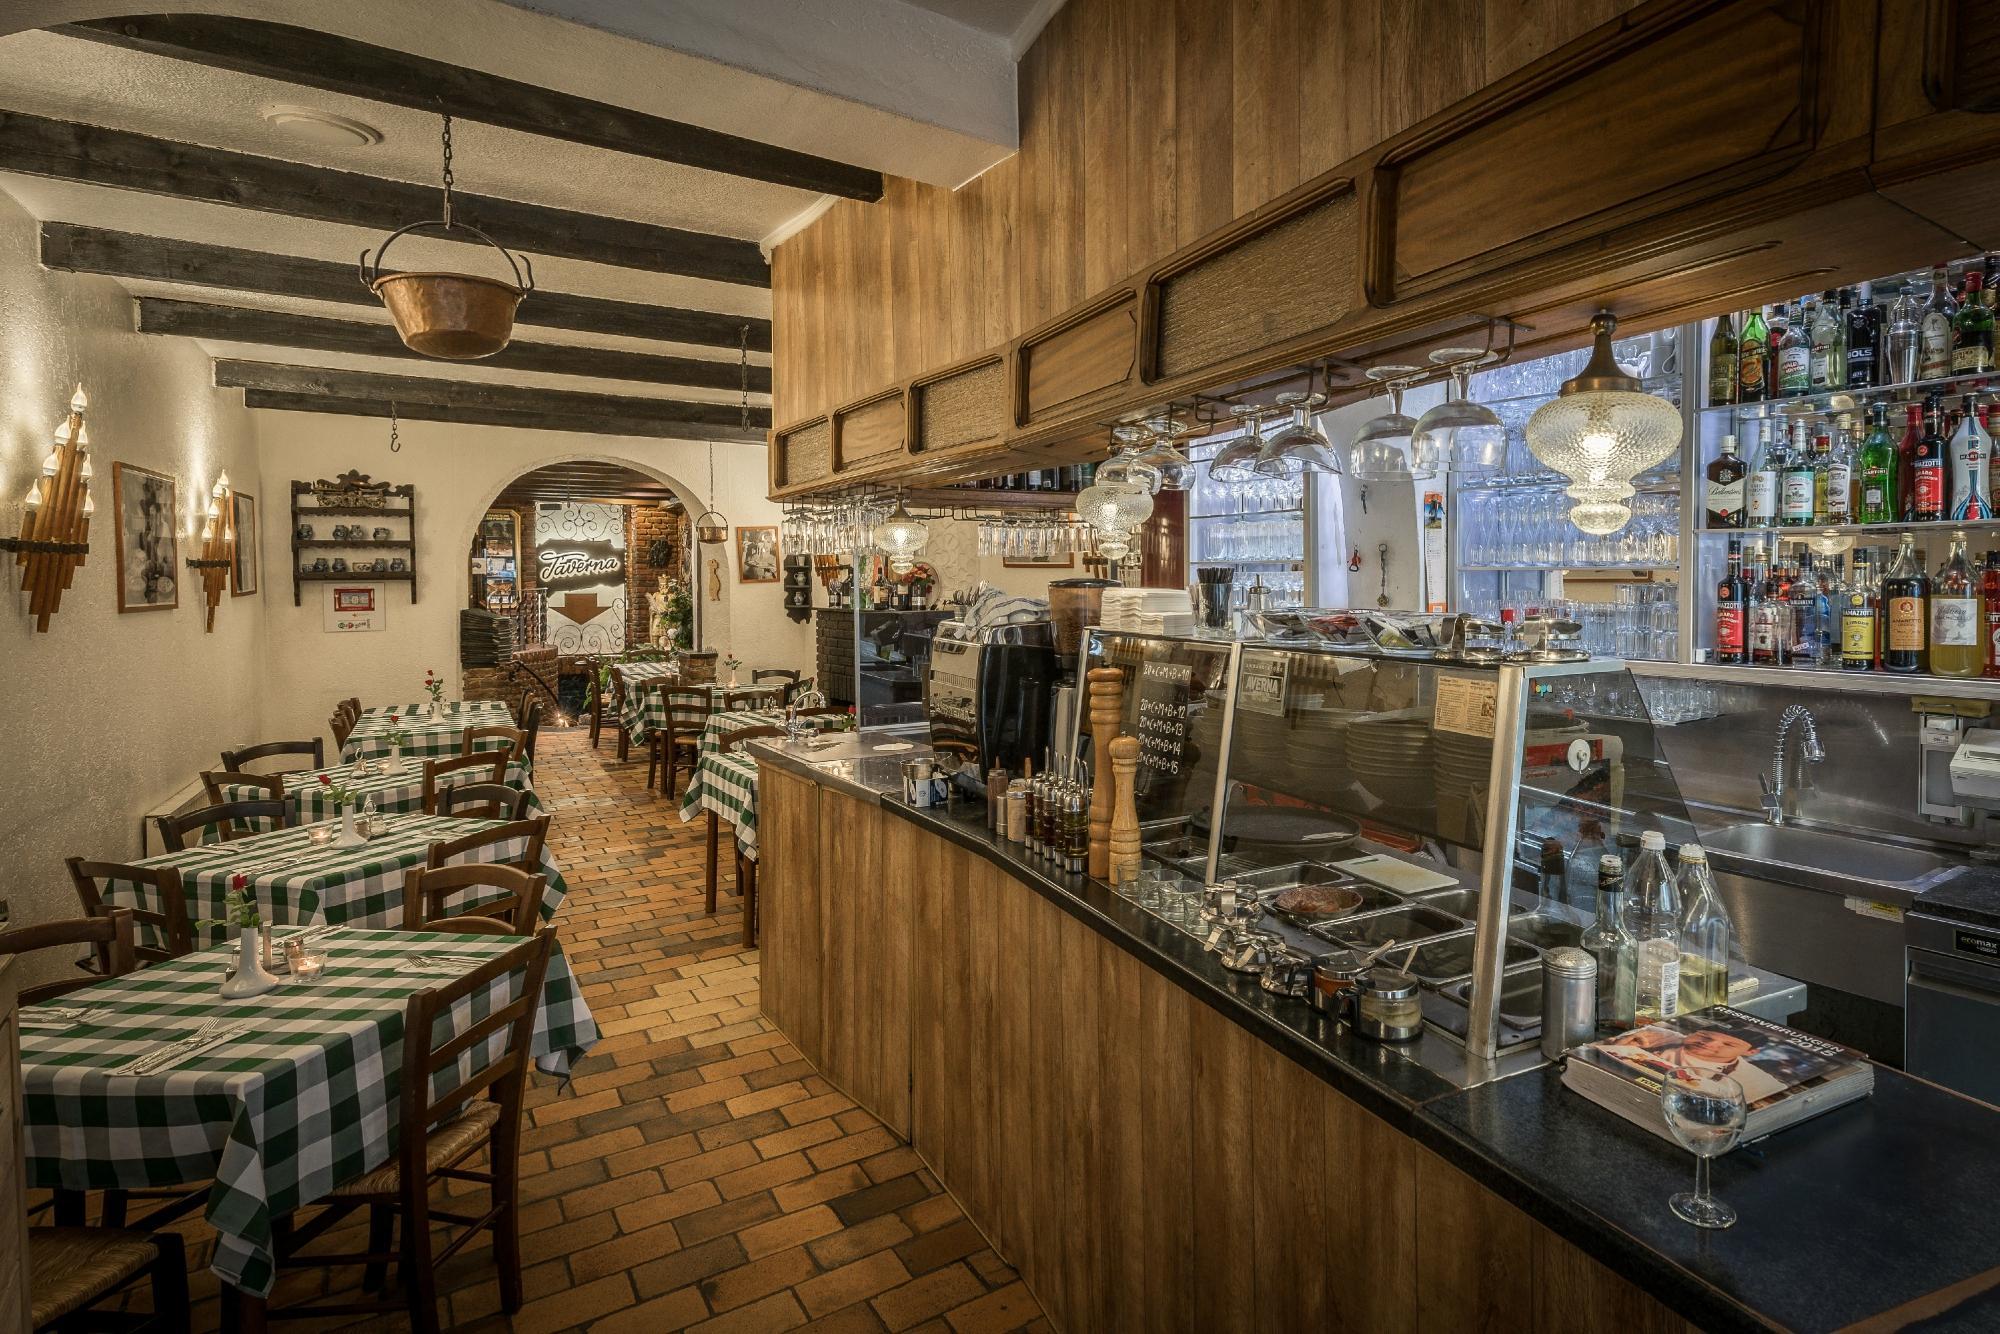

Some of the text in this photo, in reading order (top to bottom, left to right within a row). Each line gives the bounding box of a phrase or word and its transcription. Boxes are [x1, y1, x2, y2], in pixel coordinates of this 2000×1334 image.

[1863, 468, 1887, 476] MARTINI
[540, 551, 618, 580] Taverna
[1245, 676, 1280, 694] AVERNA
[1961, 936, 1997, 949] ecomax
[1714, 1006, 1844, 1053] RESERVIERUNGEN
[1786, 1038, 1838, 1057] 2015
